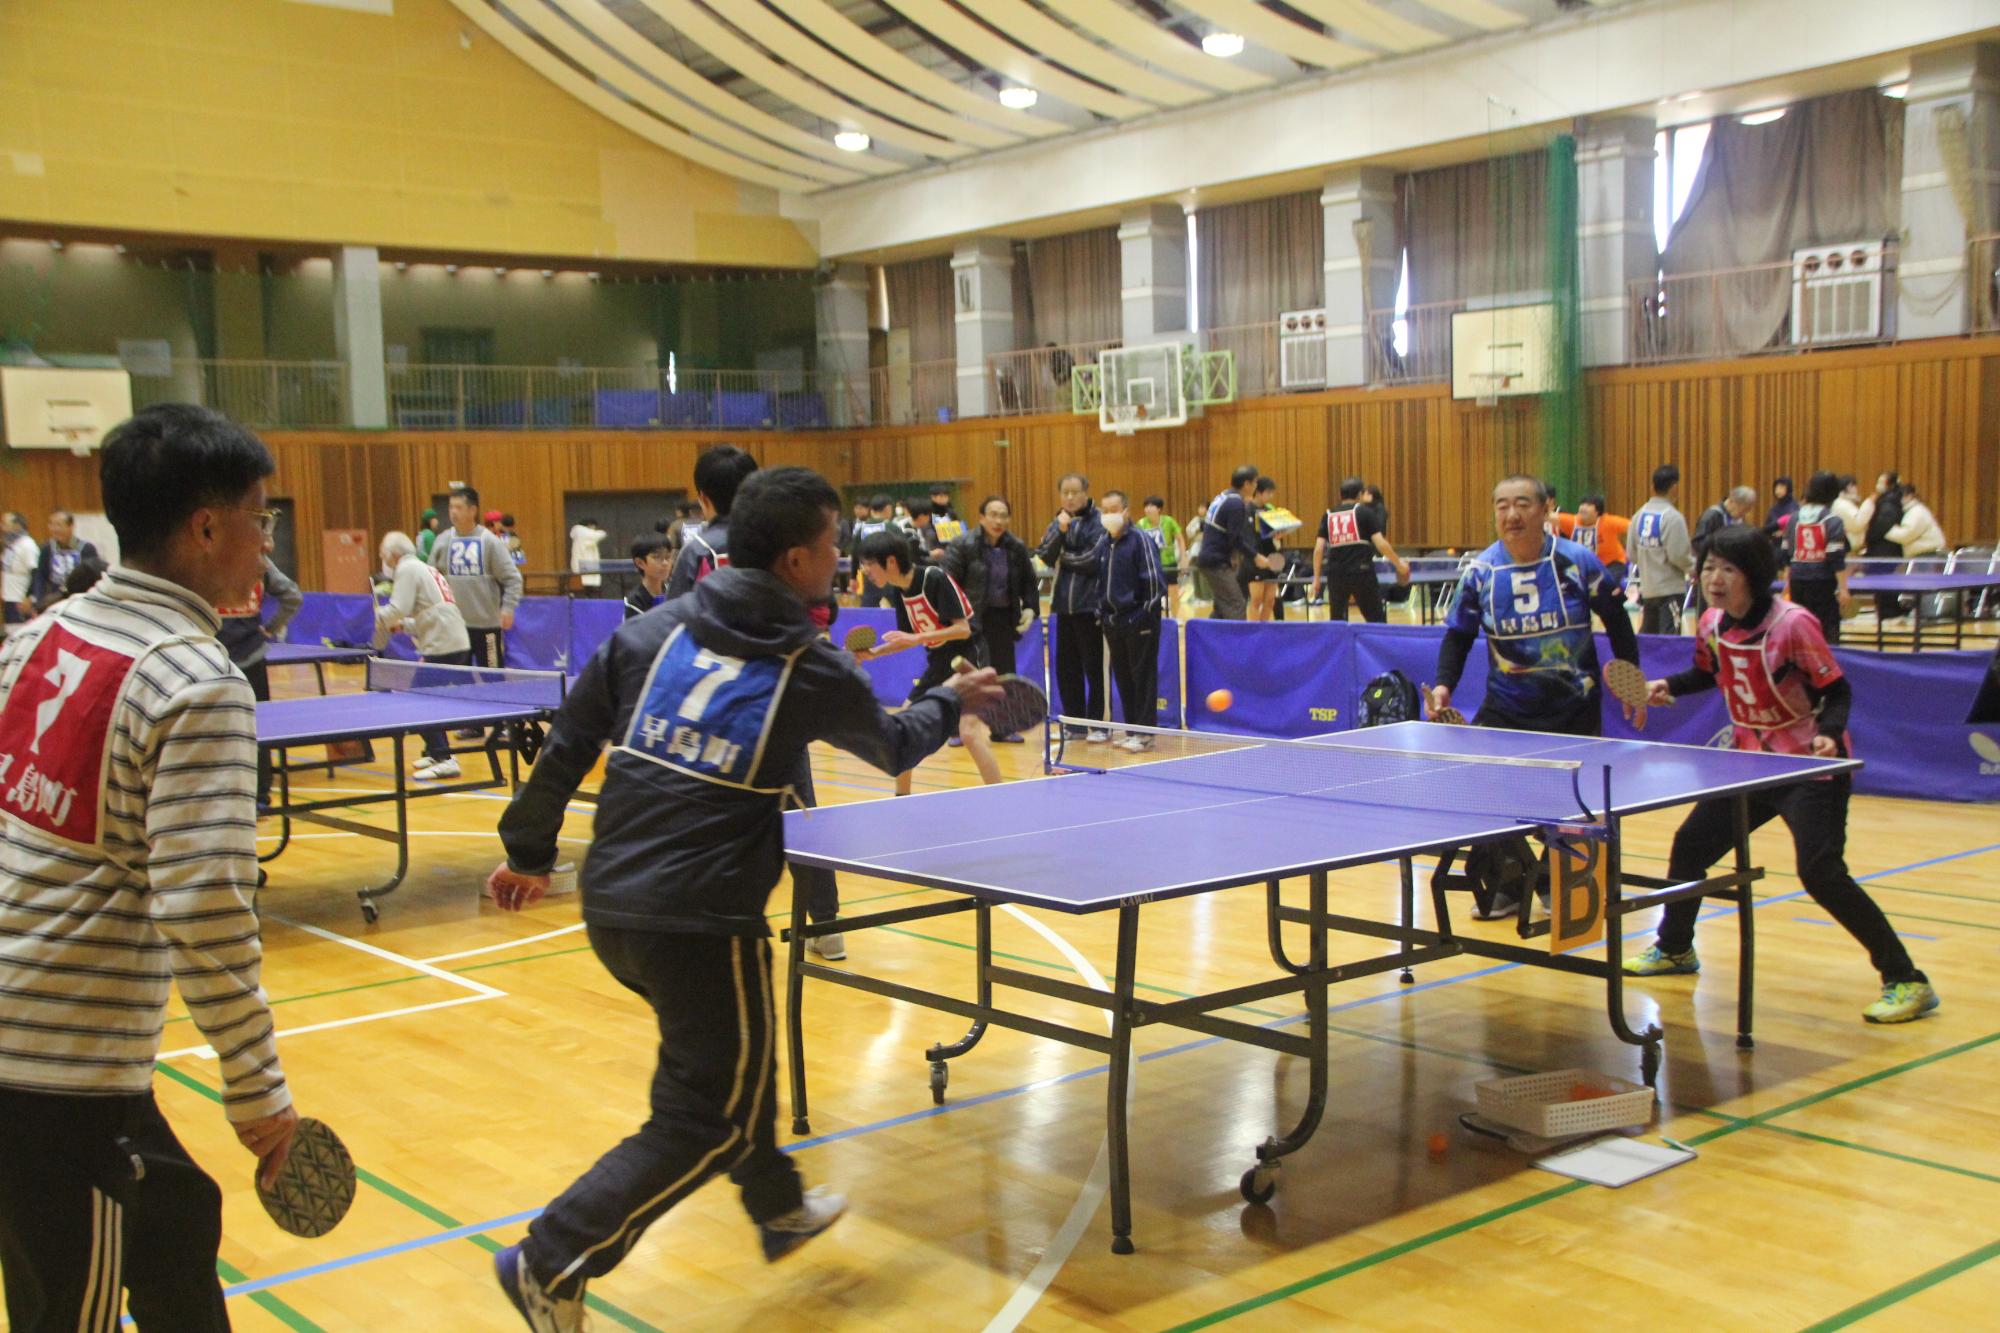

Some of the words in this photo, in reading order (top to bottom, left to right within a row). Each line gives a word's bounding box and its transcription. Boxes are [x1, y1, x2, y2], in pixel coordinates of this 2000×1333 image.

[1331, 515, 1352, 535] 17
[451, 541, 480, 564] 24
[1510, 571, 1540, 615] 5
[30, 648, 91, 755] 7
[678, 648, 746, 722] 7
[1729, 655, 1757, 705] 5
[1309, 707, 1338, 722] TSP
[638, 713, 742, 774] 早島町
[1558, 836, 1599, 941] B
